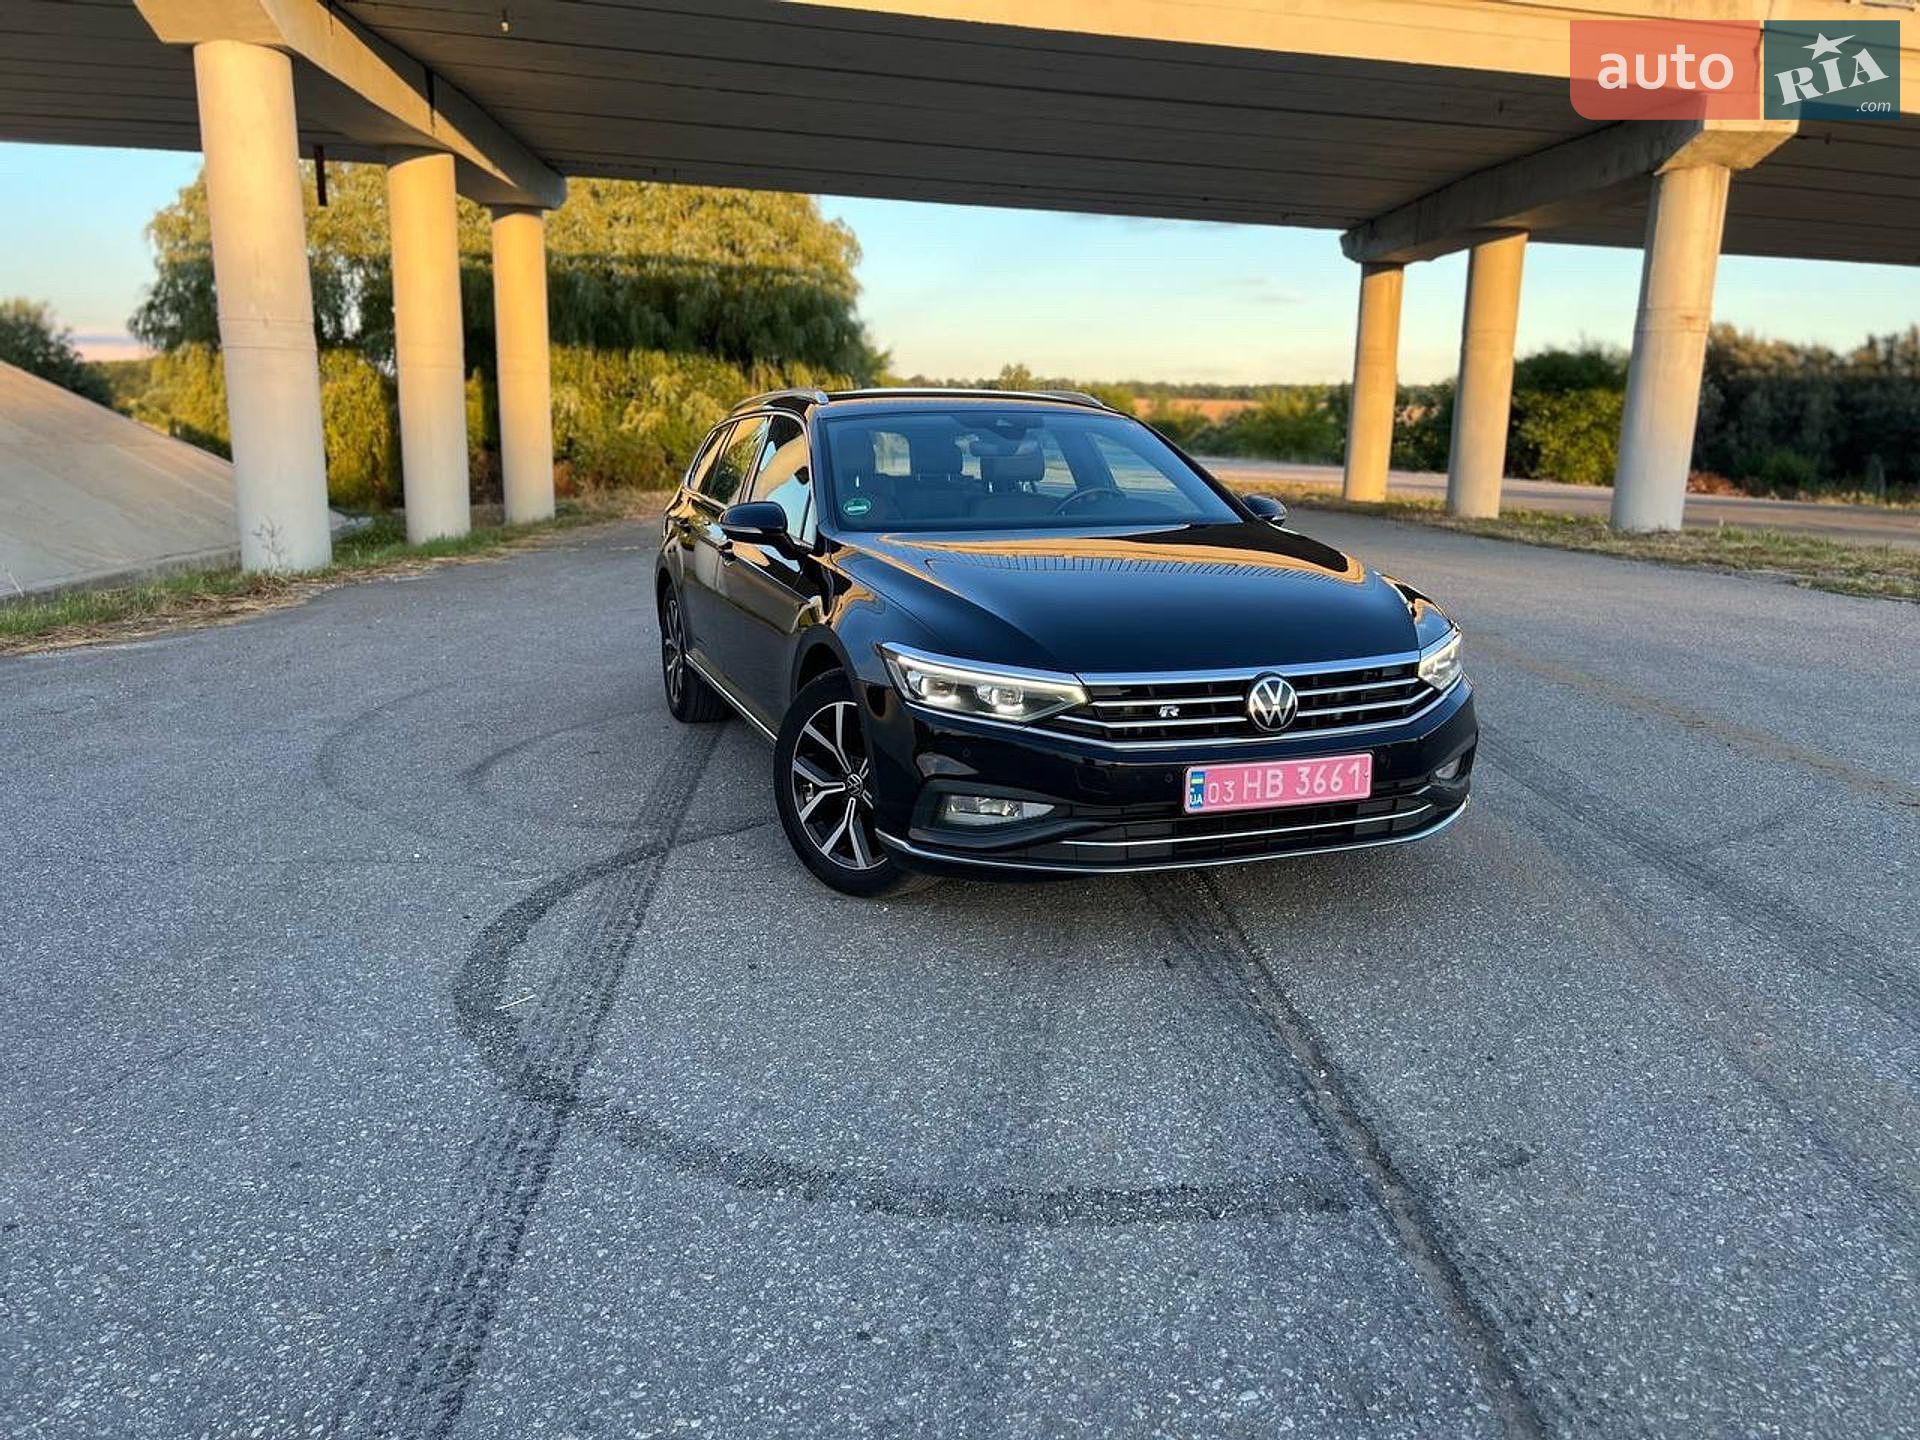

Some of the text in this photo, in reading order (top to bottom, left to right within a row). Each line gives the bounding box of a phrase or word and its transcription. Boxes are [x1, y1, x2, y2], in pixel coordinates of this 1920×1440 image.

[1250, 678, 1298, 730] VW
[1189, 793, 1203, 804] UA
[1207, 761, 1361, 804] 03 HB 3661
